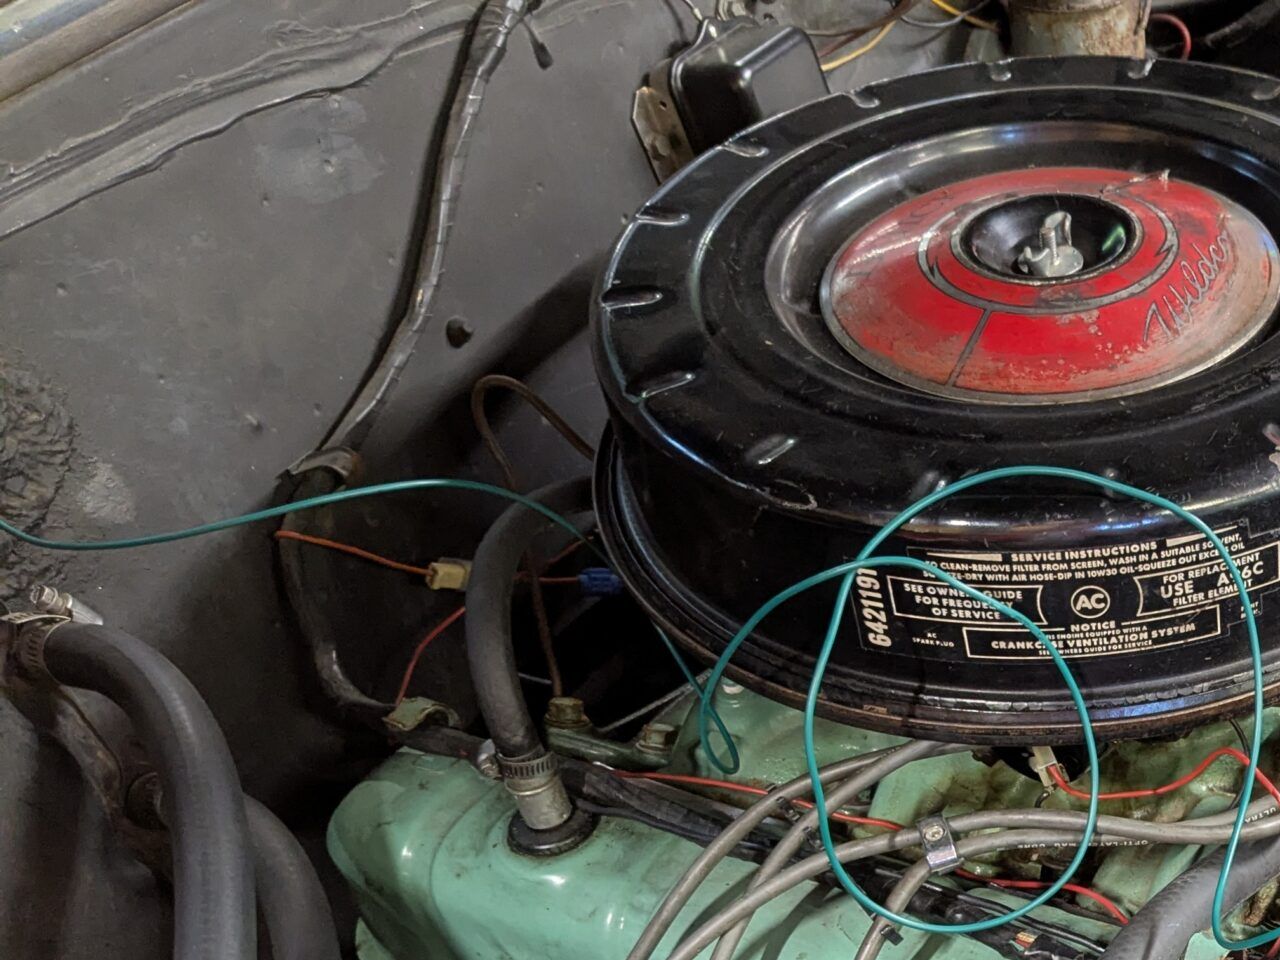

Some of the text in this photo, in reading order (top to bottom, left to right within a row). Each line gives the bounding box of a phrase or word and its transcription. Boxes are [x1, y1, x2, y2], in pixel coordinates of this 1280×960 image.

[939, 562, 1011, 572] CLEAN-REMOVE
[1012, 563, 1040, 572] FILTER
[1041, 562, 1069, 571] FROM
[1070, 560, 1108, 570] SCREEN,
[1108, 555, 1137, 566] WASH
[1138, 553, 1149, 562] IN
[1151, 552, 1159, 560] A
[1160, 542, 1201, 559] SUITABLE
[1011, 541, 1158, 563] SERVICE INSTRUCTIONS
[985, 573, 1010, 582] WITH
[1011, 573, 1027, 582] AIR
[1029, 571, 1073, 581] HOSE-DIP
[1074, 570, 1086, 579] IN
[1086, 567, 1118, 578] 10W30
[1119, 558, 1177, 574] OIL-SQUEEZE
[1179, 554, 1197, 565] OUT
[1230, 542, 1246, 552] OIL
[1162, 552, 1261, 584] FOR REPLACMENT
[903, 583, 1023, 600] SEE OWNE GUIDE
[1160, 580, 1194, 599] USE
[855, 568, 892, 647] 6421191
[915, 595, 940, 605] FOR
[1075, 593, 1106, 611] AC
[1173, 593, 1205, 607] FILTER
[931, 607, 1001, 620] OF SERVICE
[1070, 620, 1116, 632] NOTICE
[1085, 629, 1121, 638] EQUIPPED
[1122, 626, 1141, 634] WITH
[990, 622, 1196, 649] CRANKCSE VENTILATION SYSTEM
[1083, 645, 1107, 653] GUIDE
[1108, 643, 1123, 651] FOR
[1124, 640, 1153, 649] SERVICE
